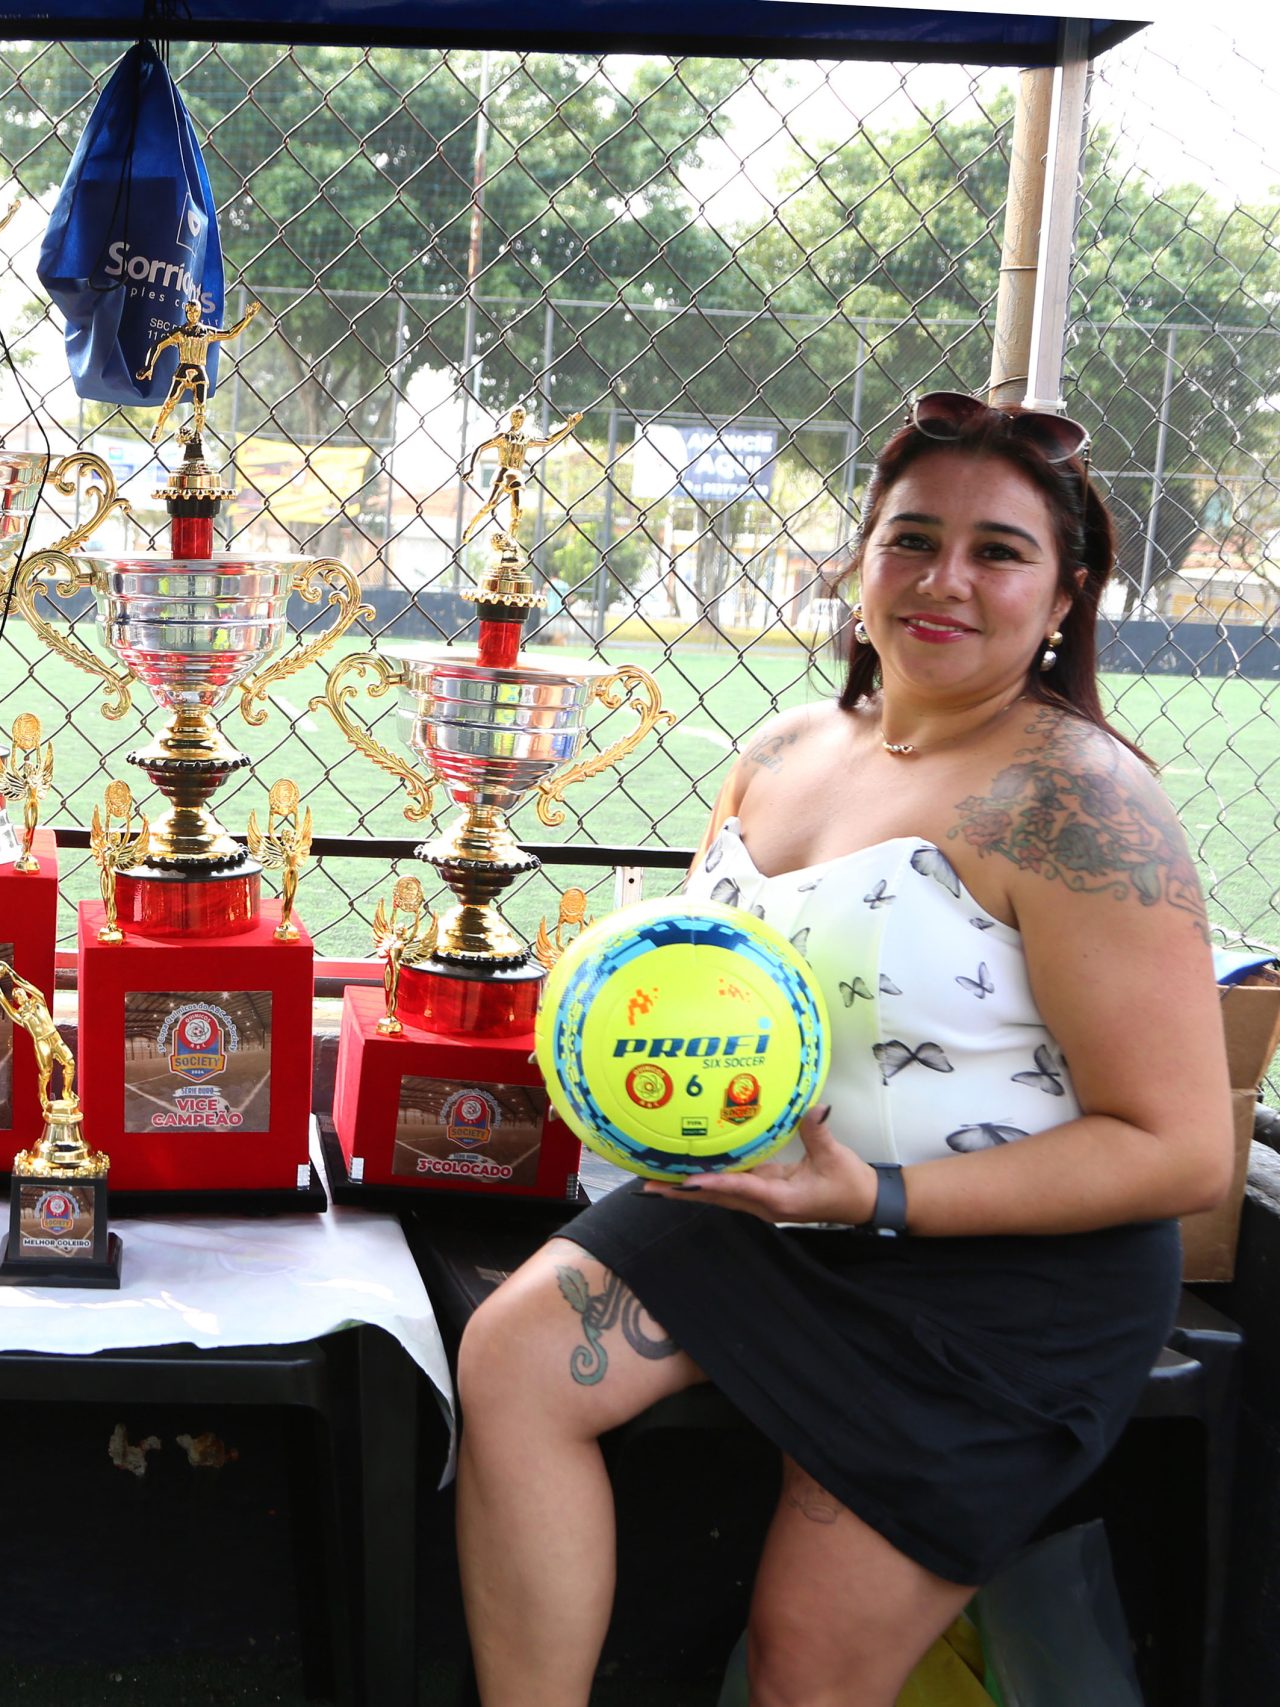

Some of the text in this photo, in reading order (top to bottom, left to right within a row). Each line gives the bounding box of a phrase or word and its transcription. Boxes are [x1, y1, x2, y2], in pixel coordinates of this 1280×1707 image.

[149, 317, 171, 331] SBC
[175, 1056, 219, 1067] SOCIETY
[702, 1056, 766, 1070] SIX SOCCER
[685, 1073, 704, 1097] 6
[176, 1097, 219, 1112] VICE
[151, 1110, 244, 1127] CAMPEÃO
[23, 1238, 56, 1247] MELHOR
